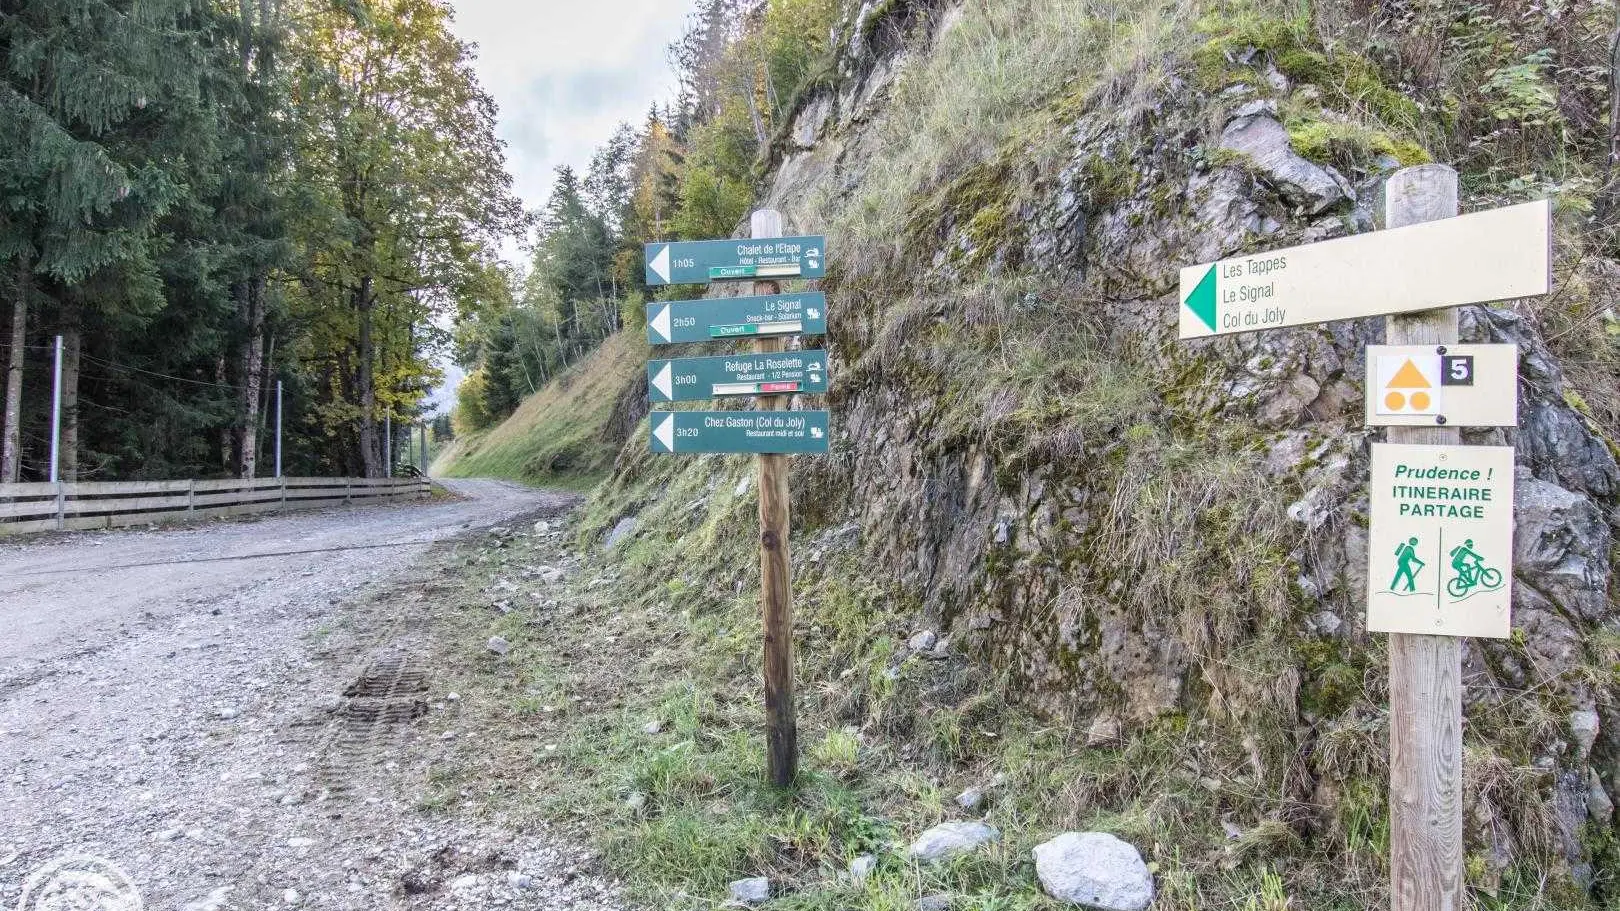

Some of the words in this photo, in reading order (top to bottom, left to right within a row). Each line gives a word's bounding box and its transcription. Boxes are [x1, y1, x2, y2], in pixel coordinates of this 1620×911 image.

[737, 244, 762, 255] Chalet
[763, 244, 774, 254] de
[672, 259, 695, 268] 1h05
[759, 256, 787, 264] Restaurant
[1223, 264, 1243, 279] Les
[1247, 256, 1287, 275] Tappes
[1223, 289, 1236, 304] Le
[1239, 281, 1274, 303] Signal
[765, 301, 776, 312] Le
[777, 299, 802, 312] Signal
[673, 317, 696, 327] 2h50
[1223, 312, 1241, 329] Col
[1244, 311, 1258, 326] du
[1261, 307, 1286, 325] Joly
[720, 326, 745, 334] Ouvert
[725, 362, 752, 372] Refuge
[754, 359, 765, 370] La
[766, 358, 803, 369] Roselette
[1450, 358, 1469, 380] 5
[675, 374, 697, 385] 3h00
[736, 373, 765, 381] Restaurant
[704, 416, 725, 428] Chez
[726, 417, 754, 428] Gaston
[756, 416, 772, 430] (Col
[773, 417, 785, 428] du
[785, 417, 806, 430] Joly)
[676, 428, 699, 437] 3h20
[1395, 464, 1481, 481] Prudence
[1486, 467, 1493, 481] !
[1392, 485, 1492, 501] ITINERAIRE
[1399, 503, 1485, 519] PARTAGE
